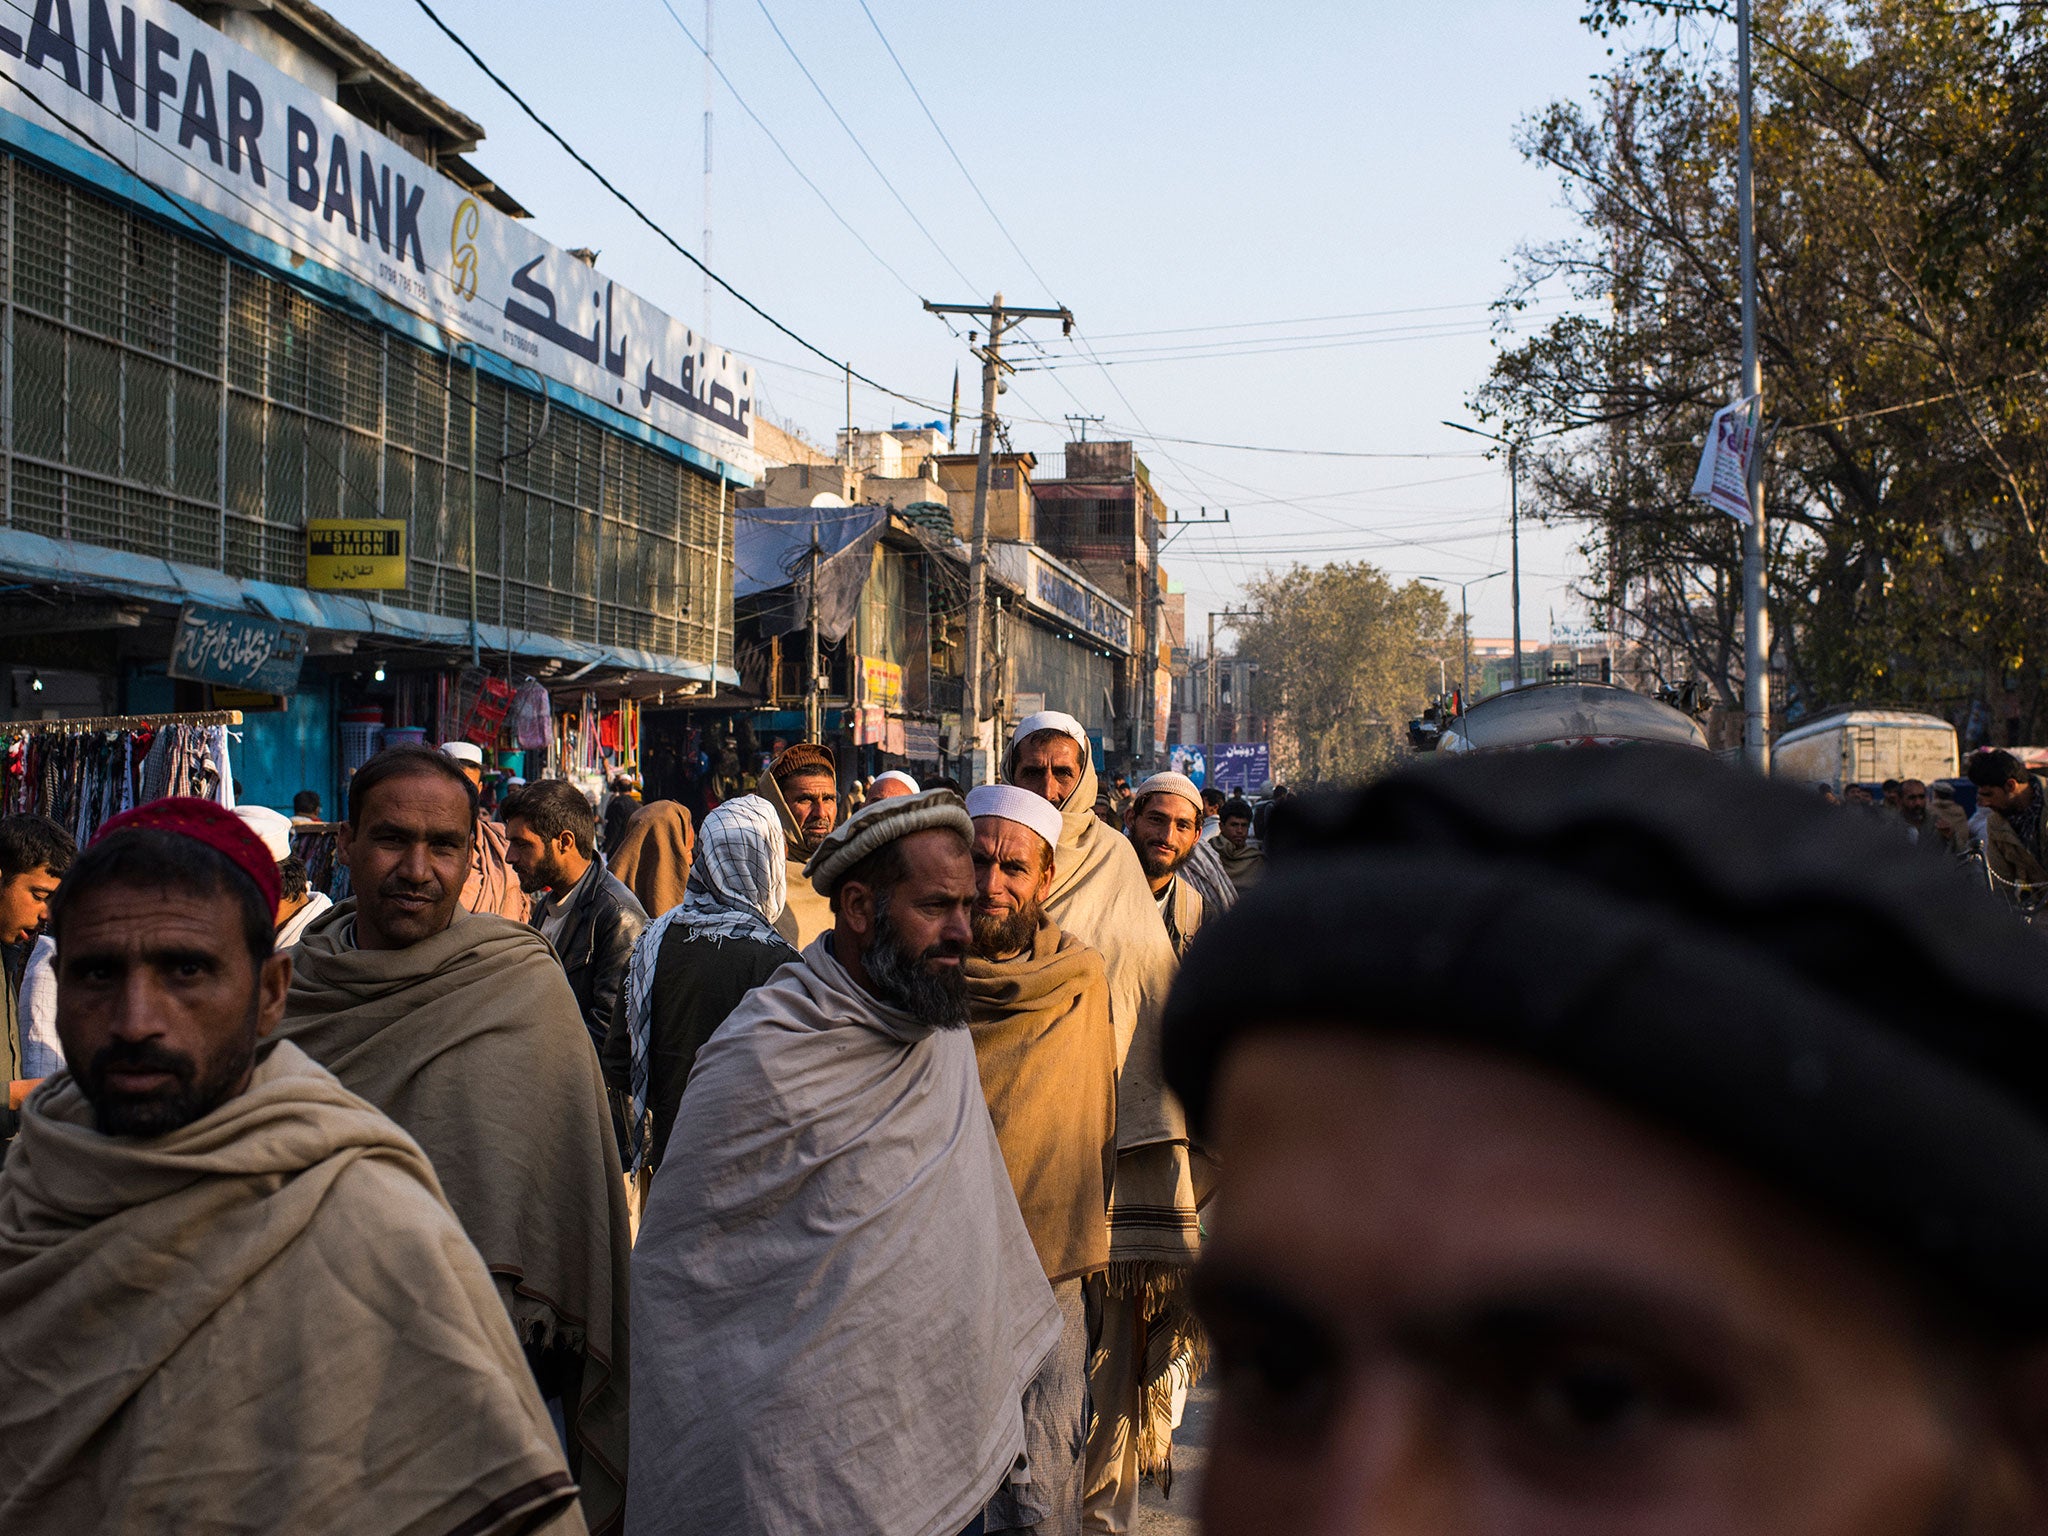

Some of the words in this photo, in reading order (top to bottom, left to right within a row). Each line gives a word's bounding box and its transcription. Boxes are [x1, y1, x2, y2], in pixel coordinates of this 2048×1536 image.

[0, 0, 266, 188] ANFAR
[287, 104, 426, 275] BANK
[640, 329, 751, 439] غضنفر
[311, 530, 384, 543] WESTERN
[332, 543, 384, 555] UNION
